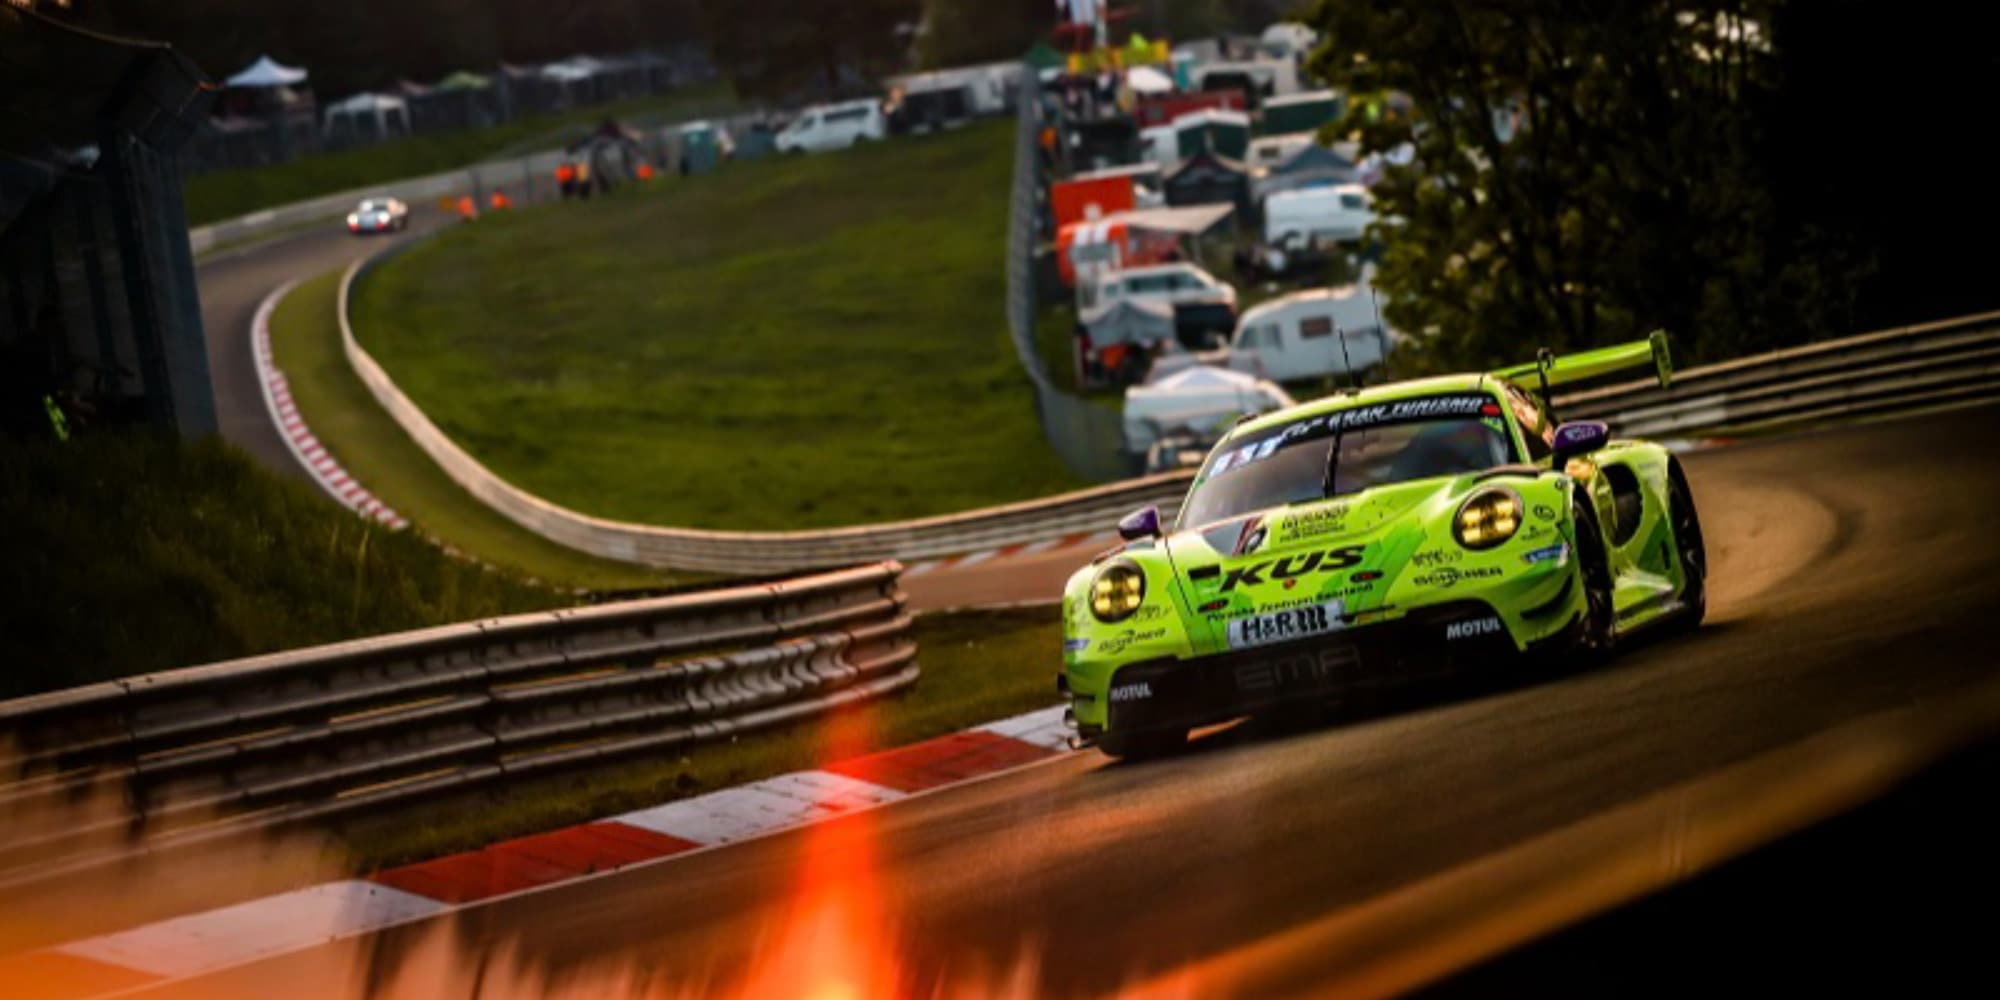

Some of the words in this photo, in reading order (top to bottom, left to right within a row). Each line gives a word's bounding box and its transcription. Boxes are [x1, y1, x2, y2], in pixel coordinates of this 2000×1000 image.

[1219, 545, 1366, 593] KÜS
[1241, 612, 1294, 641] H&R
[1446, 616, 1500, 639] MOTUL
